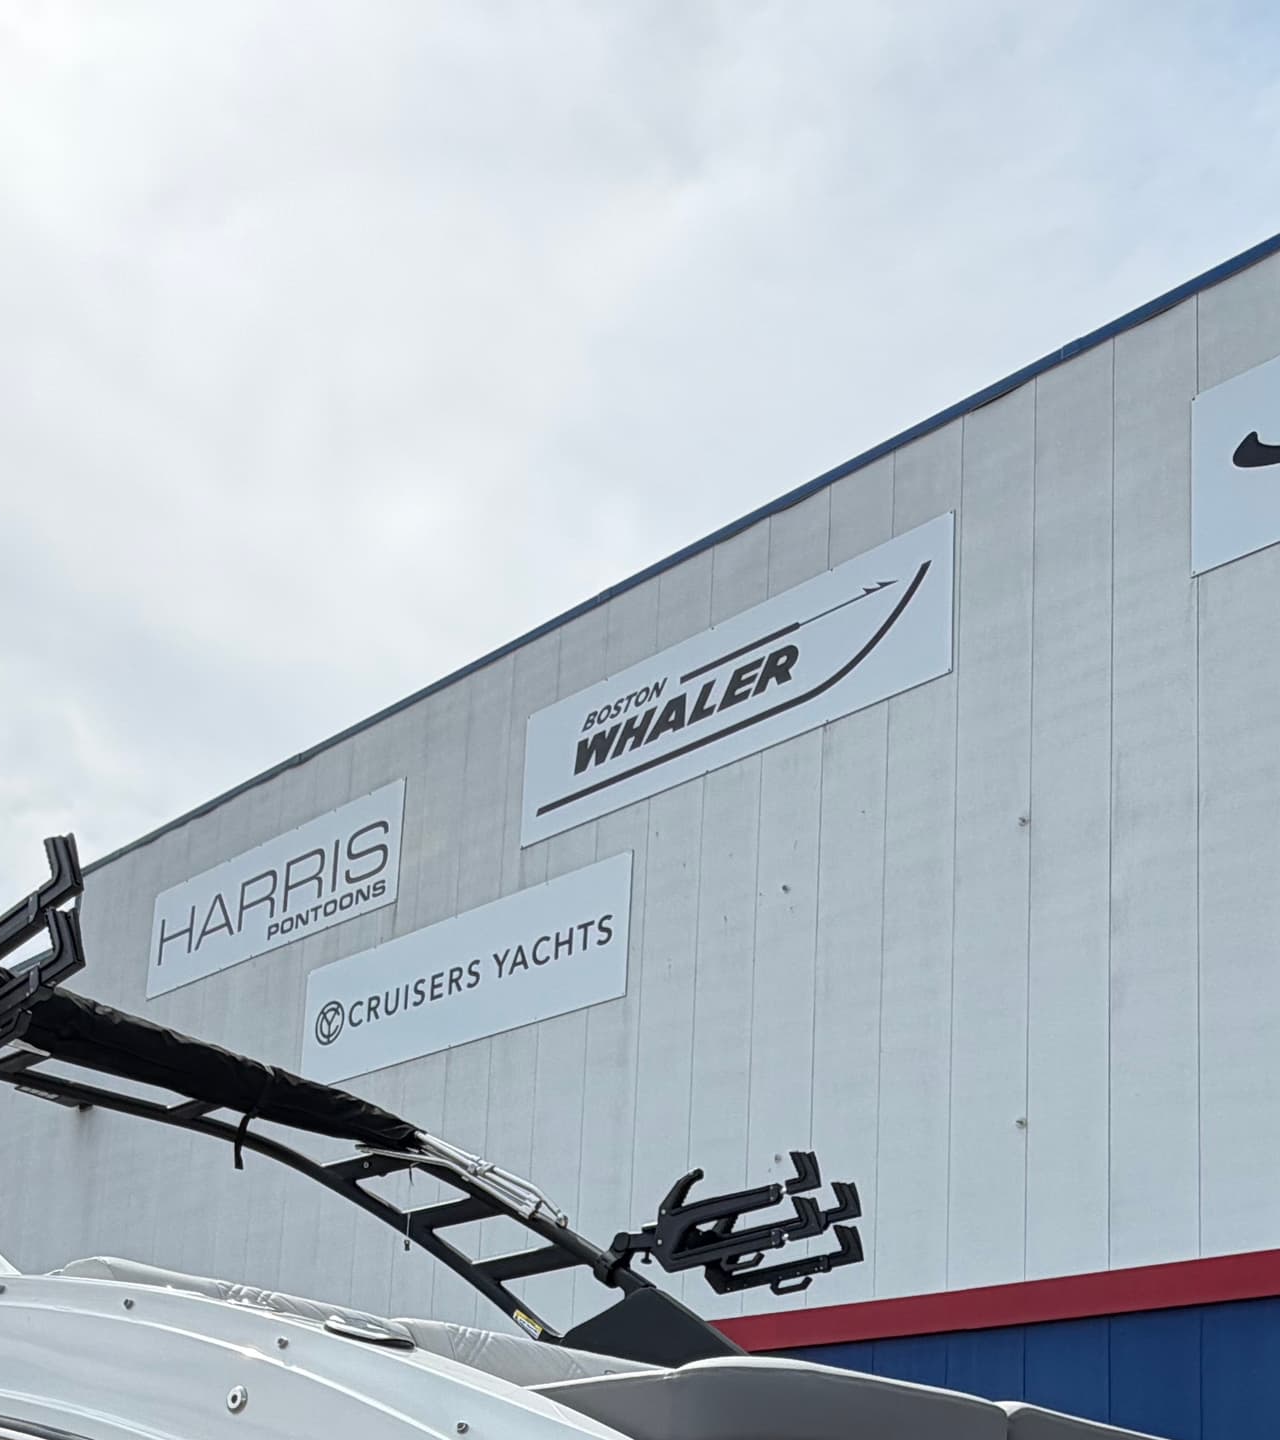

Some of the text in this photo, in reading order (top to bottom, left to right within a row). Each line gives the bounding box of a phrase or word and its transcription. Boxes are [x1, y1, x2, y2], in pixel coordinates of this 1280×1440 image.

[573, 644, 799, 775] WHALER
[581, 677, 667, 732] BOSTON
[156, 819, 389, 967] HARRIS
[266, 878, 387, 941] PONTOONS
[348, 959, 482, 1028] CRUISERS
[492, 914, 614, 979] YACHTS
